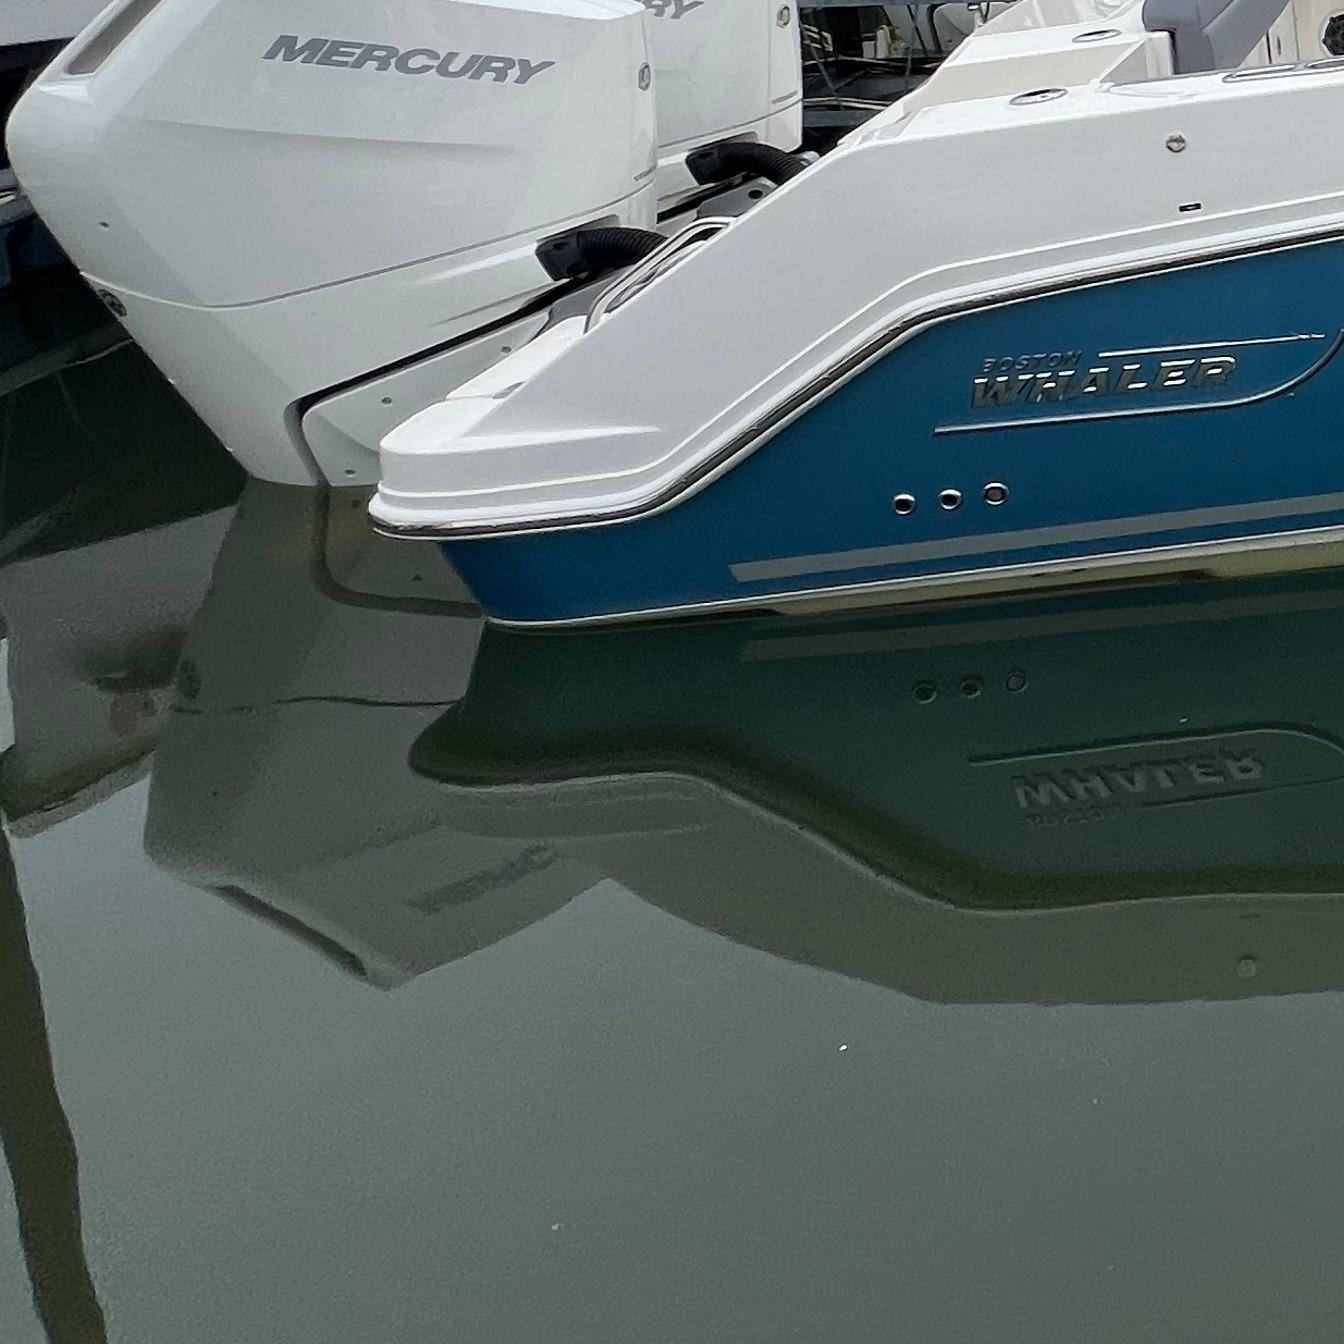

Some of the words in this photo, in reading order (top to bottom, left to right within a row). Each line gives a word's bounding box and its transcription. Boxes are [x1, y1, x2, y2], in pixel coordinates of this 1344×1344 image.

[262, 34, 556, 85] MERCURY
[970, 356, 1236, 408] WHALER
[983, 350, 1083, 372] BOSTON
